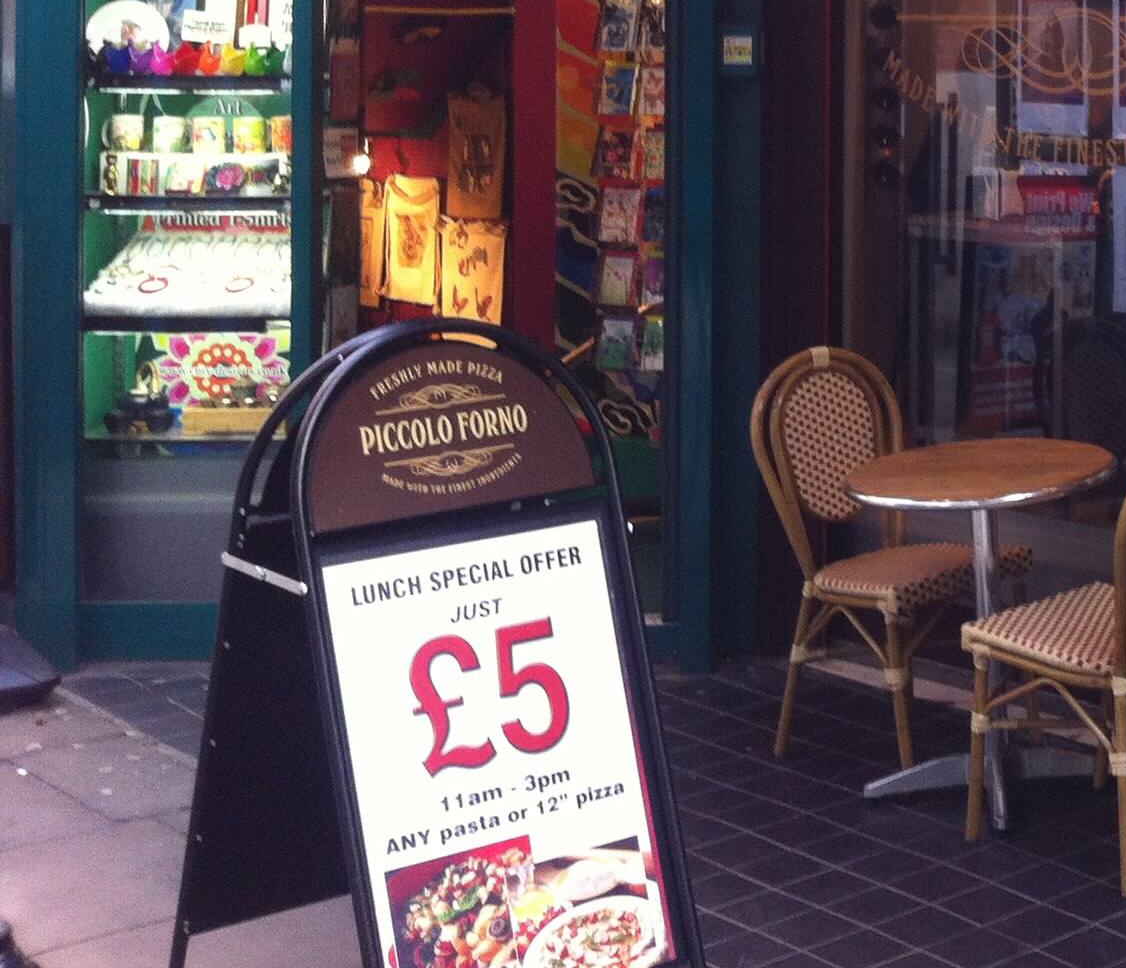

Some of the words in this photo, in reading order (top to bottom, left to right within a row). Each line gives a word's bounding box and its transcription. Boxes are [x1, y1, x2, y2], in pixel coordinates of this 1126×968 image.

[369, 363, 422, 401] FRESHLY
[426, 360, 463, 376] MADE
[467, 361, 503, 384] PIZZA
[359, 414, 453, 456] PICCOLO
[457, 404, 529, 442] FORNO
[351, 575, 422, 607] LUNCH
[430, 558, 513, 592] SPECIAL
[520, 546, 583, 574] OFFER
[451, 598, 503, 624] JUST
[409, 616, 571, 778] £5
[441, 785, 502, 812] 11am
[525, 768, 571, 798] 3pm
[386, 829, 431, 855] ANY
[440, 815, 501, 845] pasta
[508, 806, 529, 823] or
[576, 780, 625, 810] pizza
